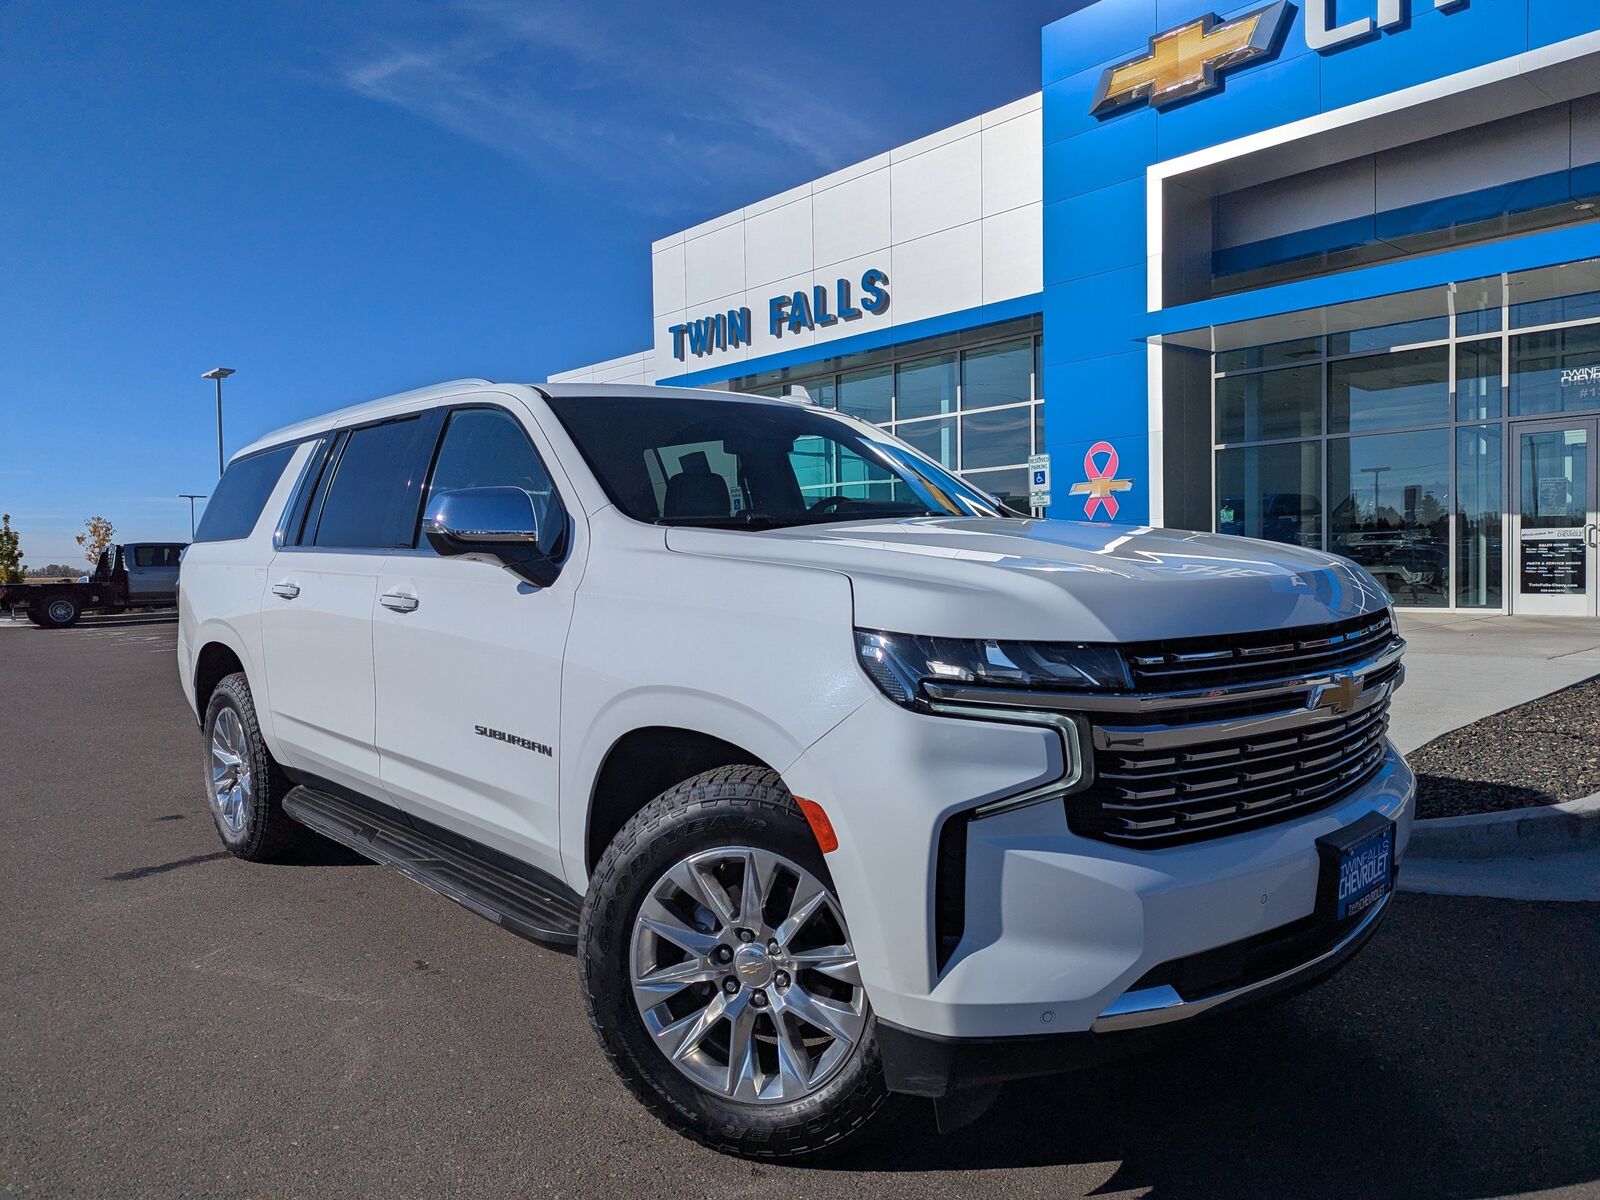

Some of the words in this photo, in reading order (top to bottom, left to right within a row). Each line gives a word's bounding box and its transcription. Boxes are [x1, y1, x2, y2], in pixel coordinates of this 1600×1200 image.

[669, 307, 751, 362] TWIN
[769, 268, 890, 339] FALLS
[474, 725, 553, 757] SUBURBAN
[1339, 853, 1389, 900] CHEVROLET
